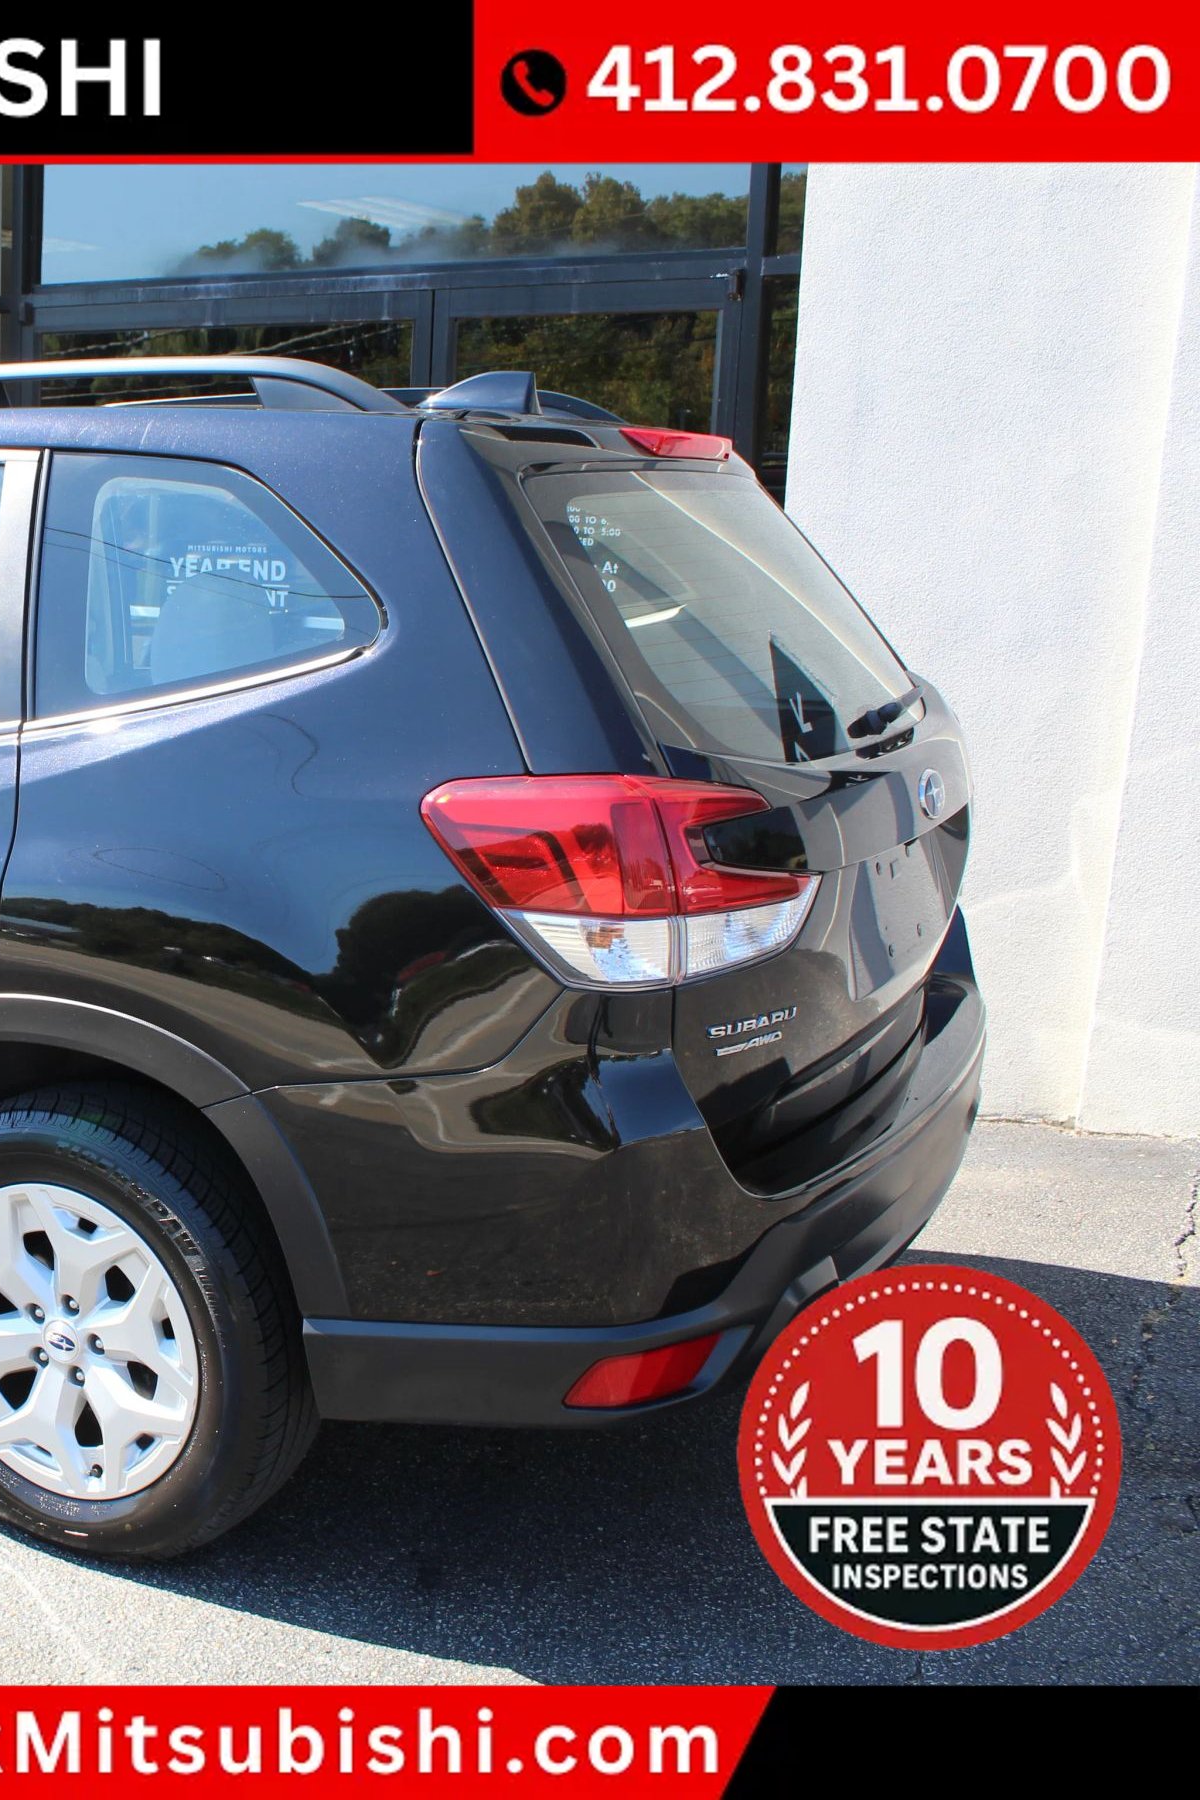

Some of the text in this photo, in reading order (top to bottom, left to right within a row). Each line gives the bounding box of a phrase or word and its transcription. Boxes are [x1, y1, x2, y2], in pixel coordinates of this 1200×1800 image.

[585, 516, 597, 524] TO
[601, 528, 621, 537] 5:00
[187, 544, 268, 554] MITSUBISHI MOTORS
[706, 1005, 798, 1039] SUBARU
[745, 1031, 783, 1050] AWD
